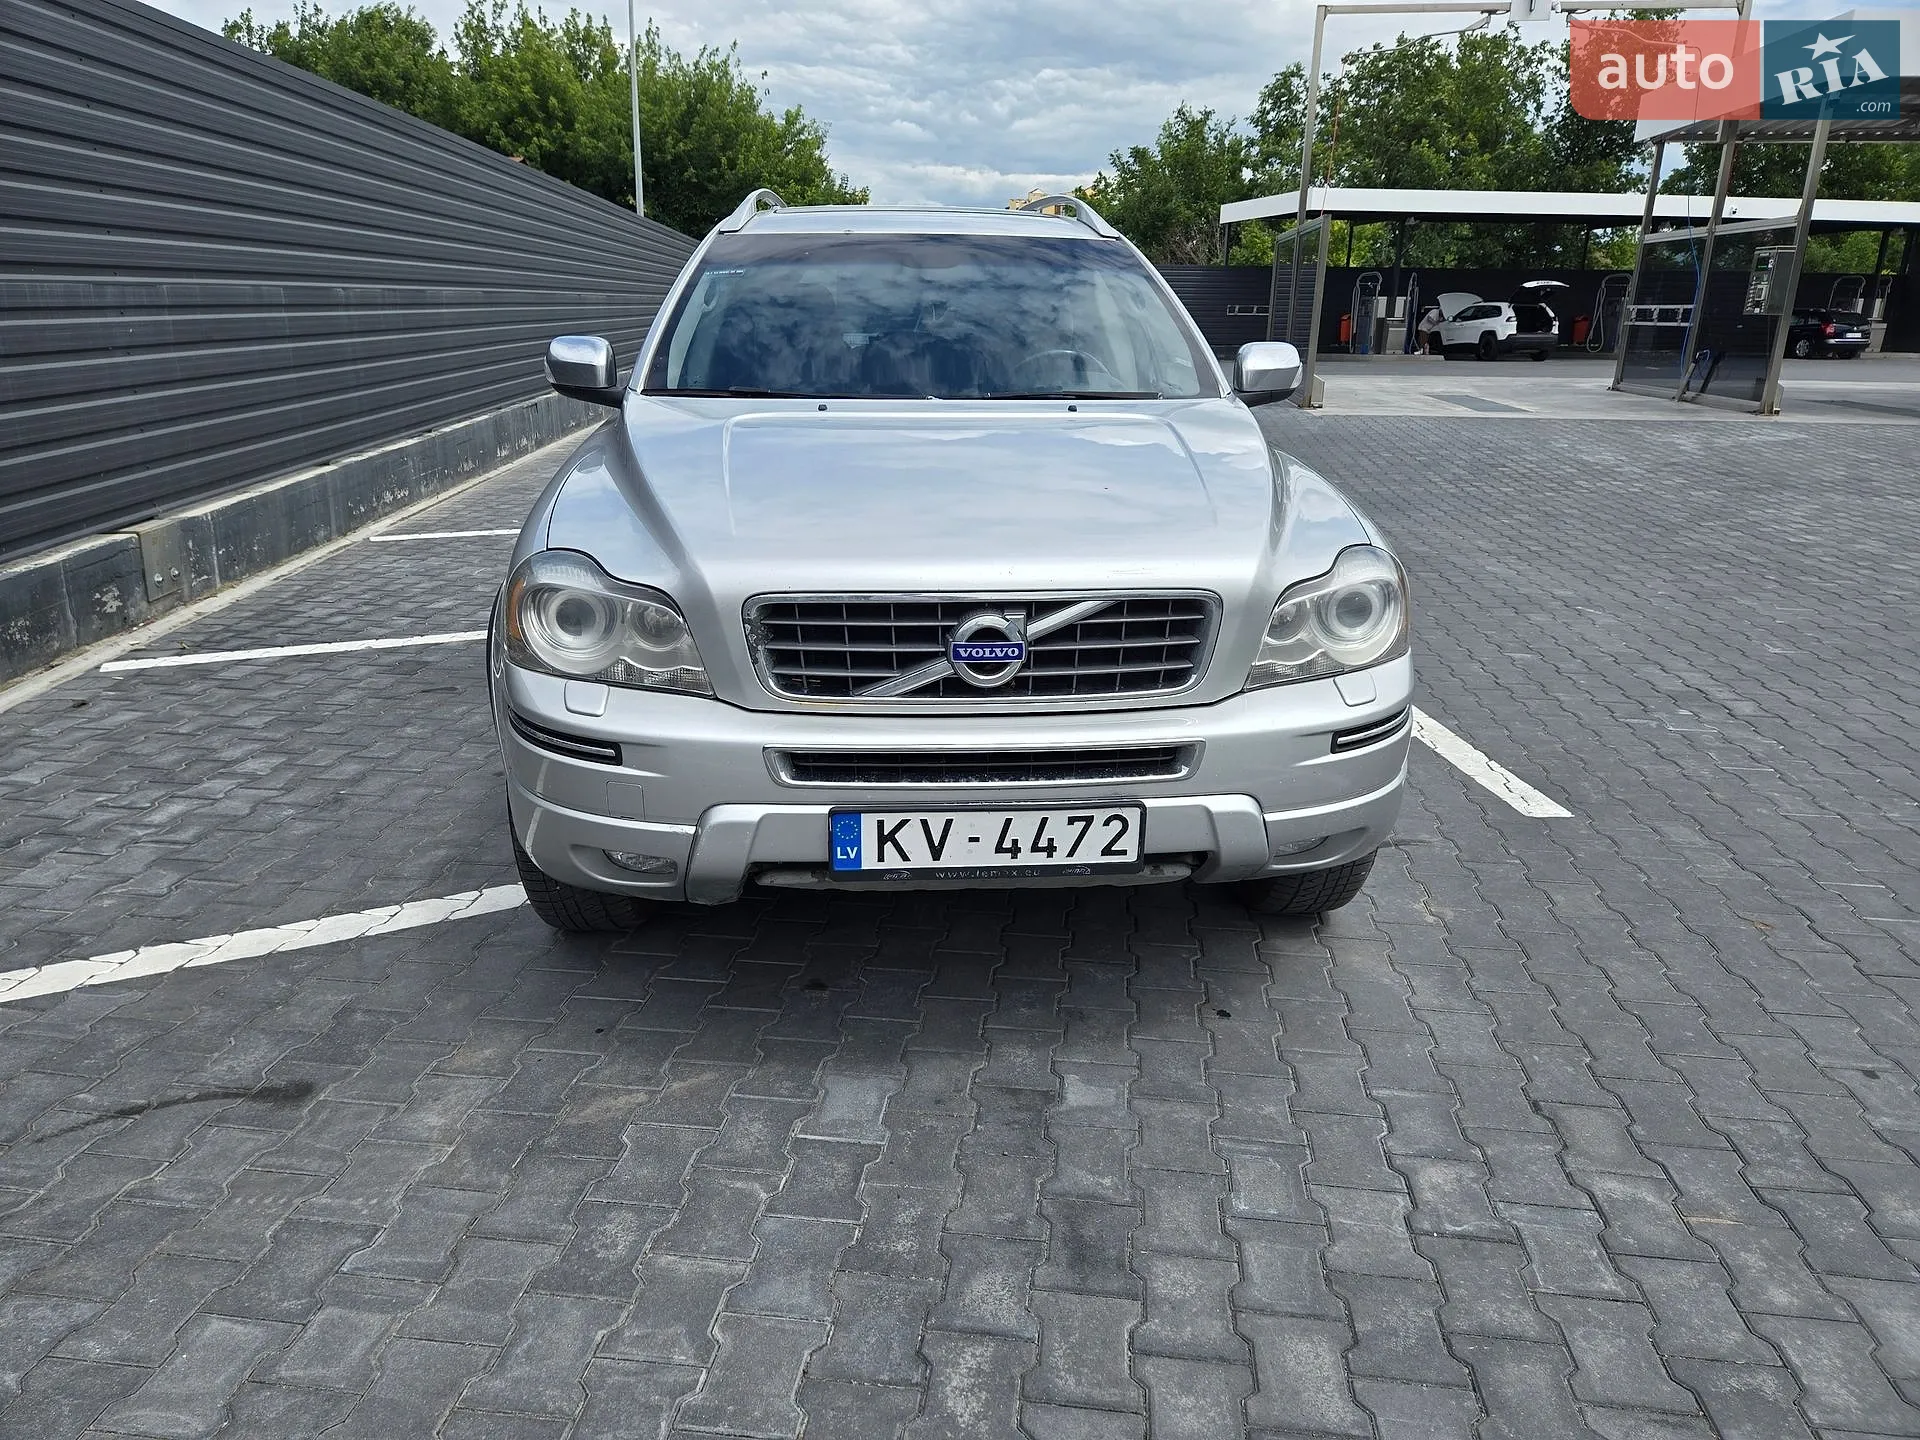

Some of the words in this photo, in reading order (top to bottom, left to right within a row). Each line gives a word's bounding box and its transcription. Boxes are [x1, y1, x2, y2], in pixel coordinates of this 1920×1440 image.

[957, 648, 1019, 657] VOLVO
[836, 847, 858, 859] LV
[877, 814, 1130, 863] KV-4472
